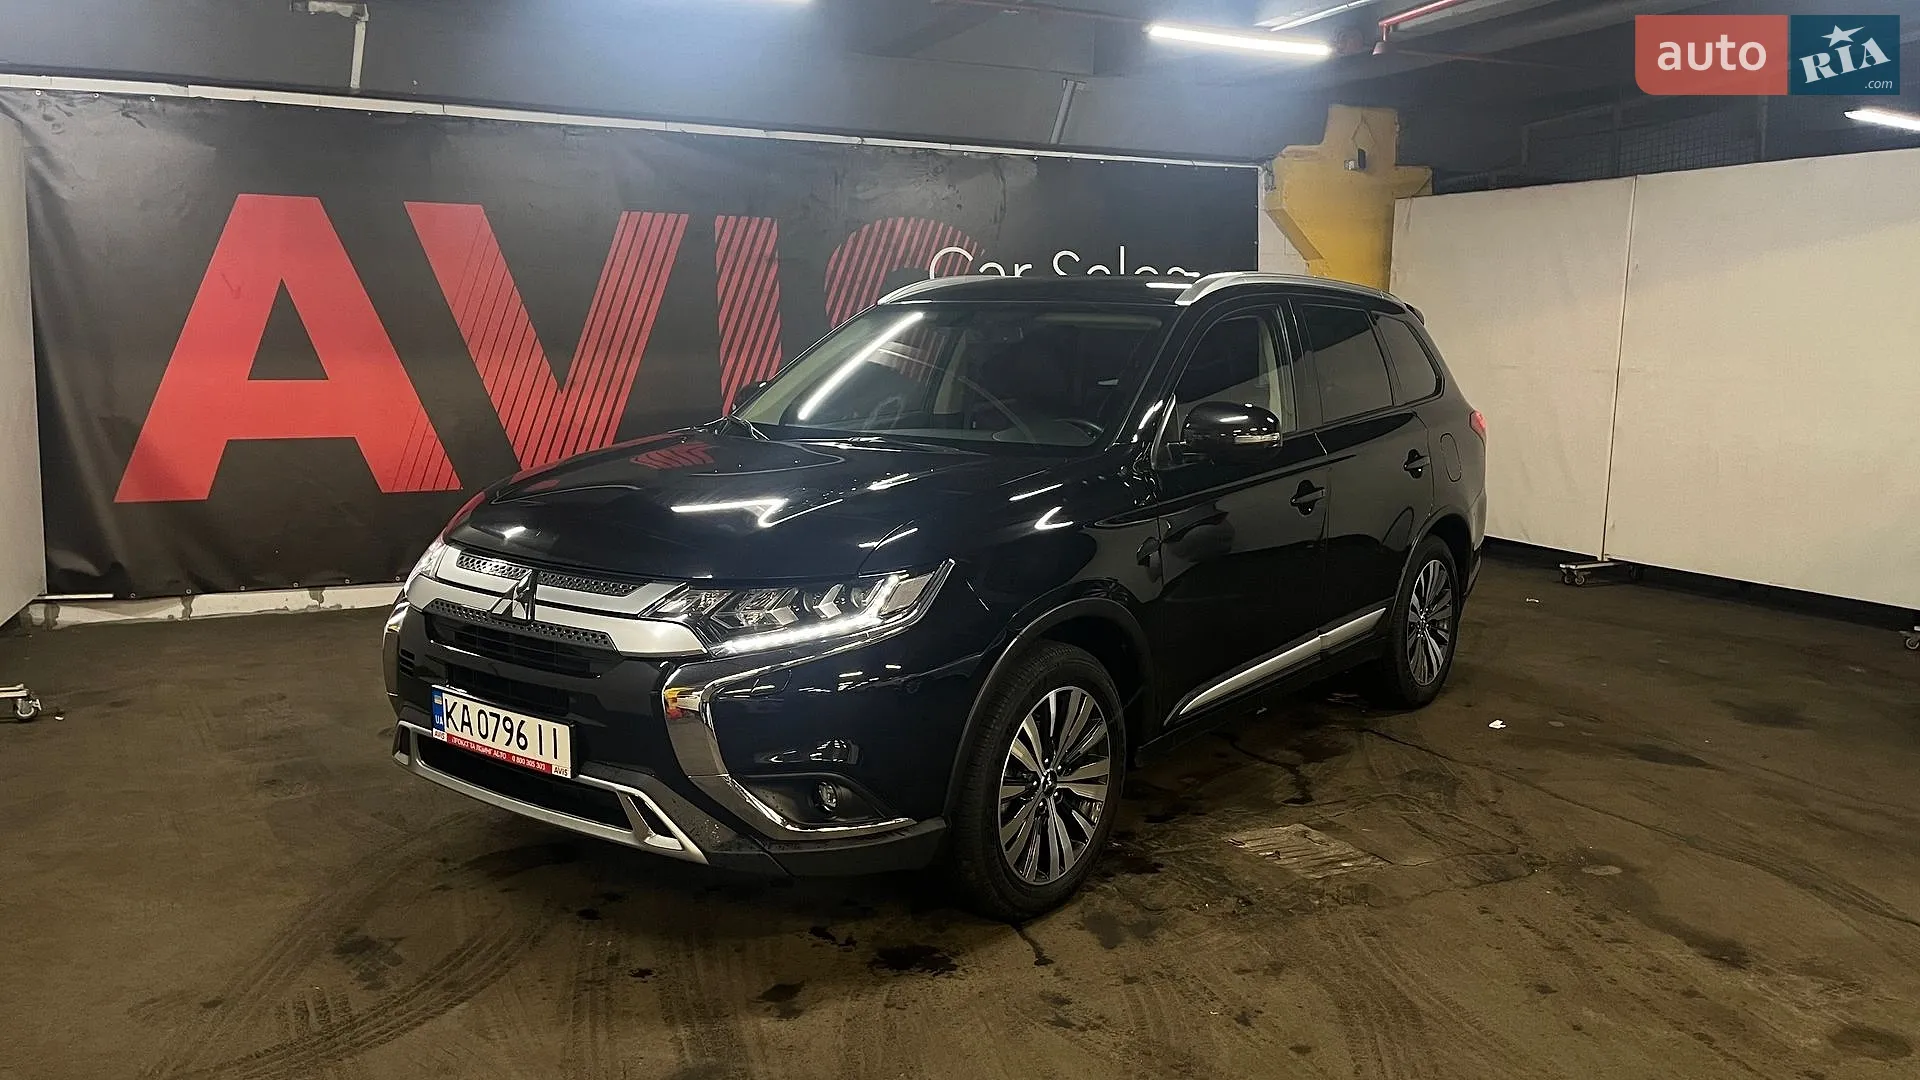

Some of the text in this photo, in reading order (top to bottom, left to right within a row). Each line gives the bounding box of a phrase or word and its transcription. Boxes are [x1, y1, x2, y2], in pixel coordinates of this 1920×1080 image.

[435, 714, 444, 726] UA
[444, 698, 474, 737] KA
[477, 709, 529, 751] 0796
[553, 766, 568, 777] AVIS
